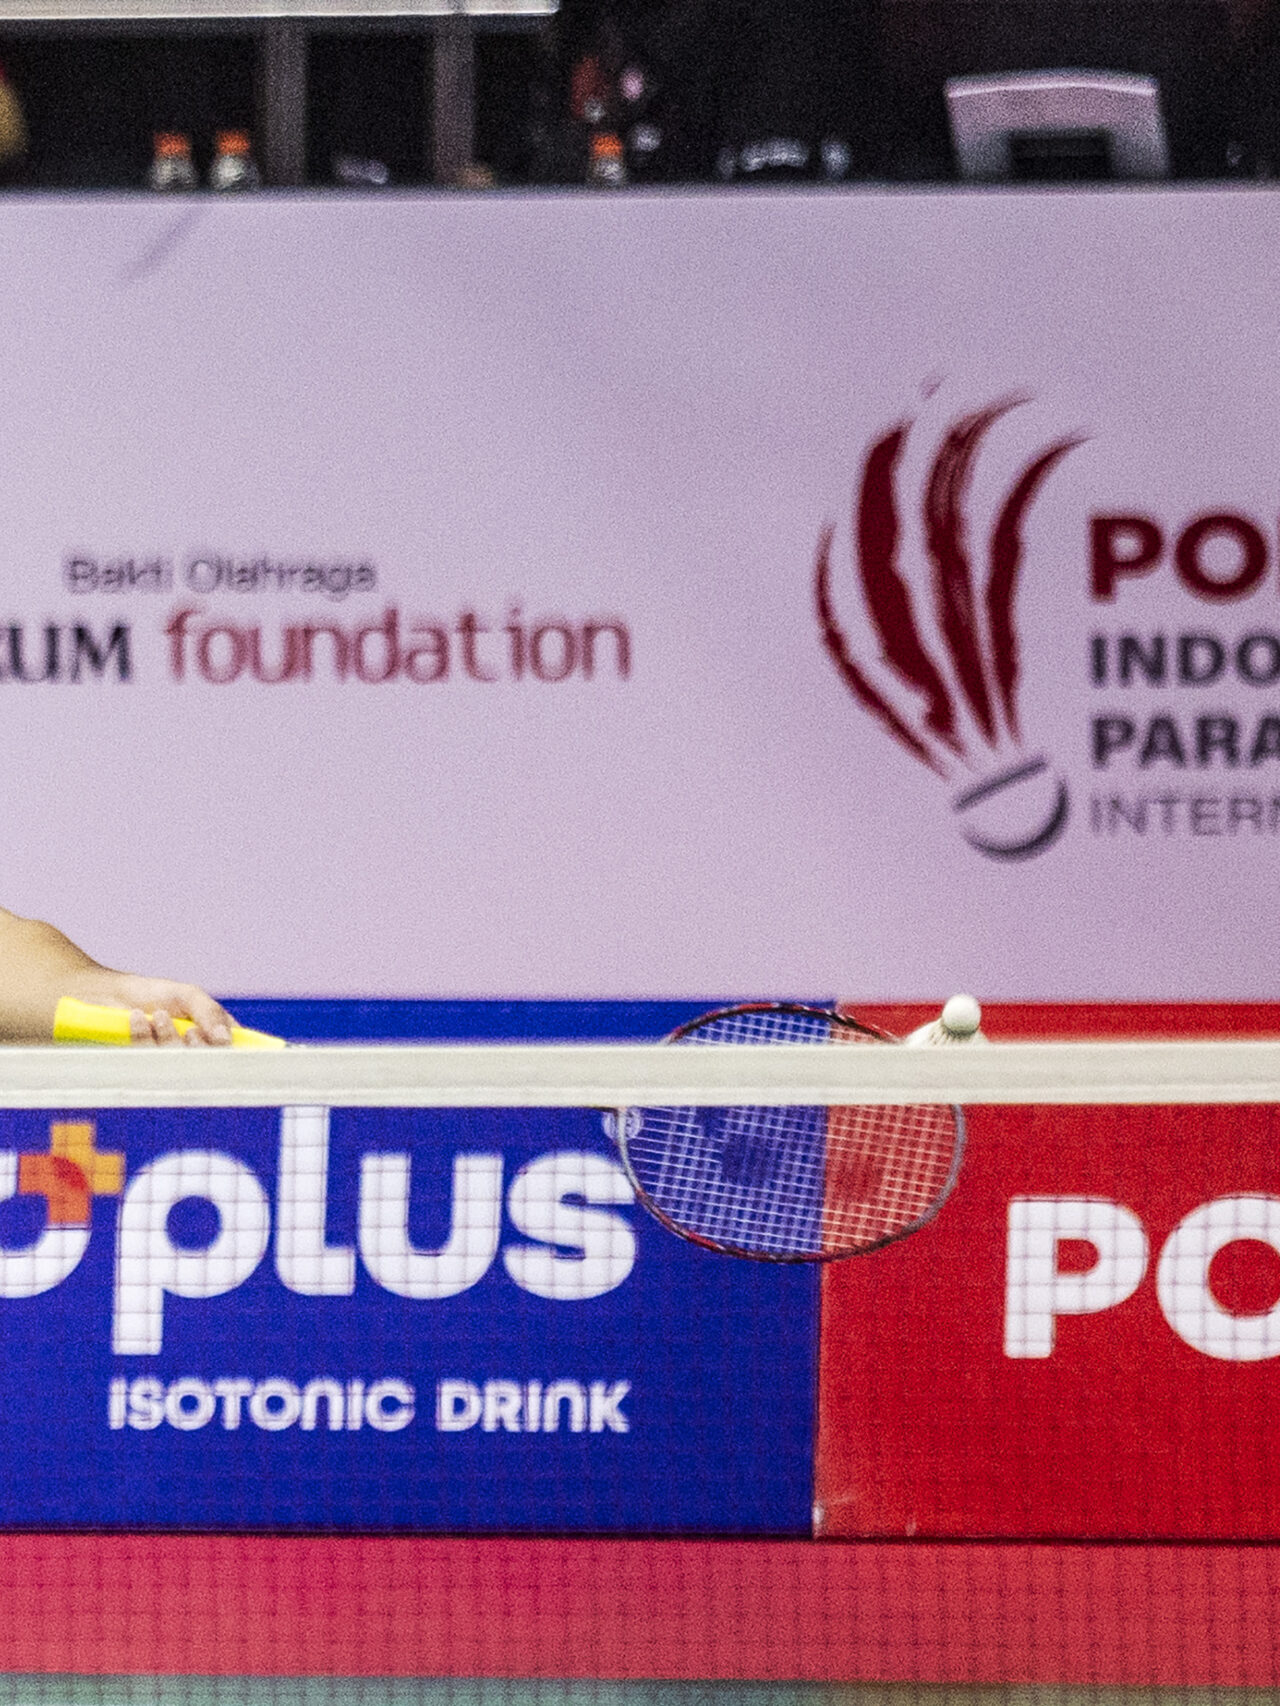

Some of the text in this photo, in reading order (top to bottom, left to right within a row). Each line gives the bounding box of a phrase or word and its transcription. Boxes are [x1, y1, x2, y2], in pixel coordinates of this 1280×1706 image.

[67, 557, 377, 602] Bakti Olahraga
[1089, 512, 1280, 602] PO
[164, 605, 632, 684] foundation
[1089, 632, 1280, 688] INDO
[1090, 712, 1280, 768] PARA
[1004, 1194, 1280, 1361] PO
[109, 1378, 631, 1433] ISOTONIC DRINK
